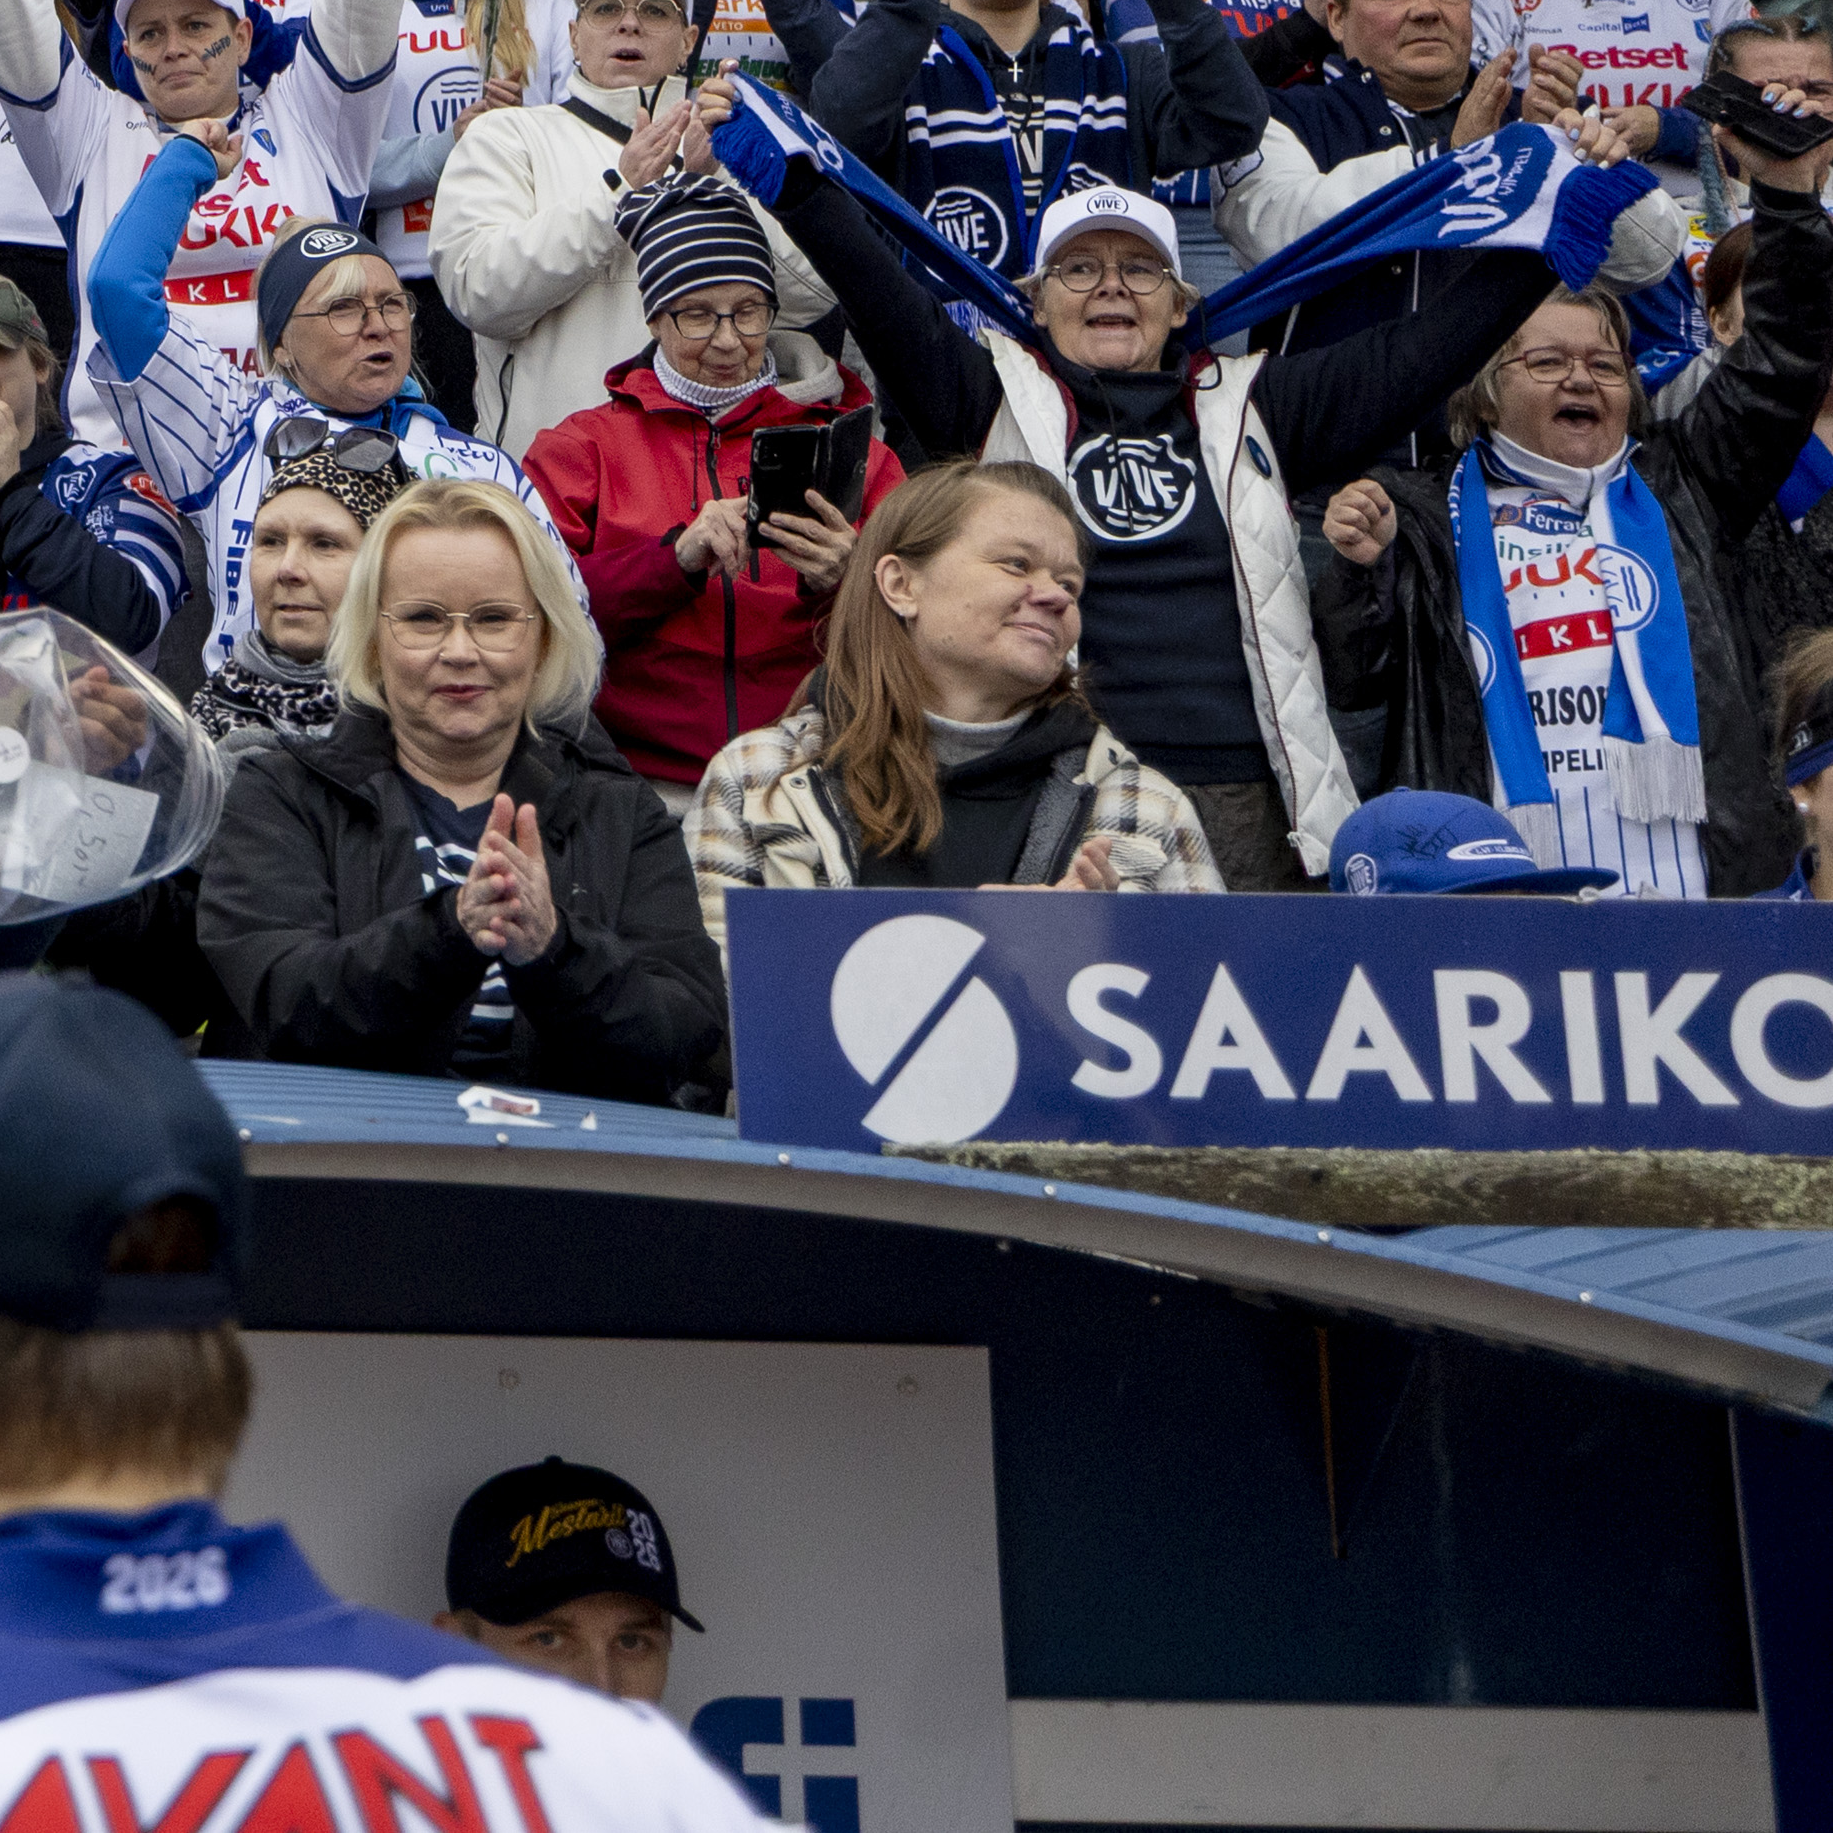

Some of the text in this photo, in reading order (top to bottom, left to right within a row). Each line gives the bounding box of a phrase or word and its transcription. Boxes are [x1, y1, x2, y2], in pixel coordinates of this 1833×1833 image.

[1094, 199, 1122, 210] VIVE
[308, 231, 349, 250] VIVE
[1092, 458, 1181, 510] VIVE
